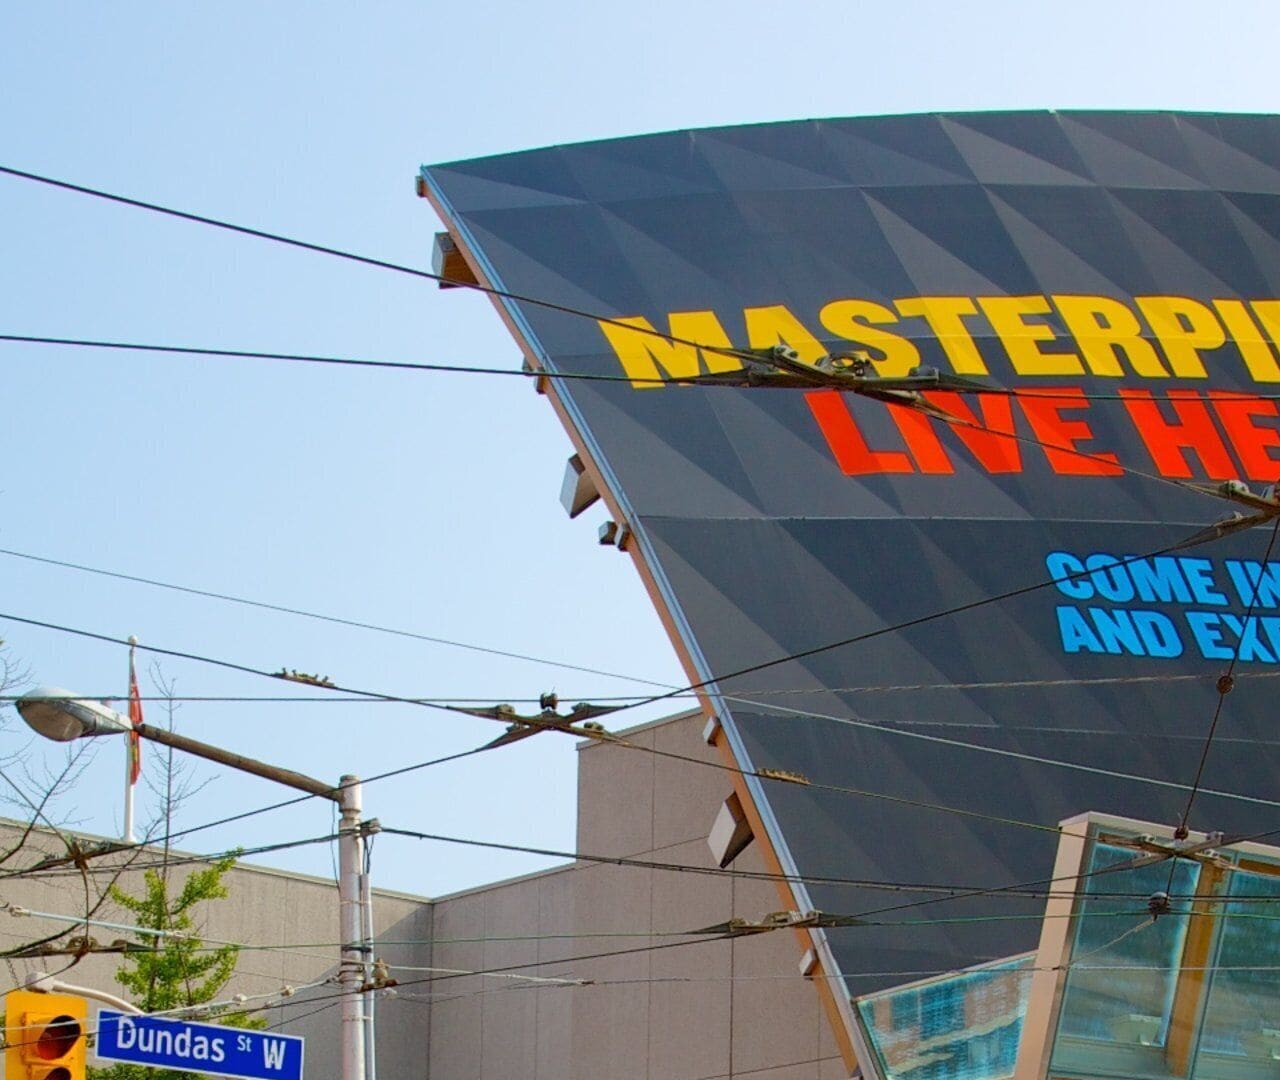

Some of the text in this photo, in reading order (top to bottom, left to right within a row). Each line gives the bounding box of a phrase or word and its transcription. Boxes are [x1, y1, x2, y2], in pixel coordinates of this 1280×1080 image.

[803, 387, 1124, 477] LIVE
[1045, 550, 1228, 606] COME
[1054, 606, 1183, 660] AND
[117, 1018, 286, 1070] Dundas St W
